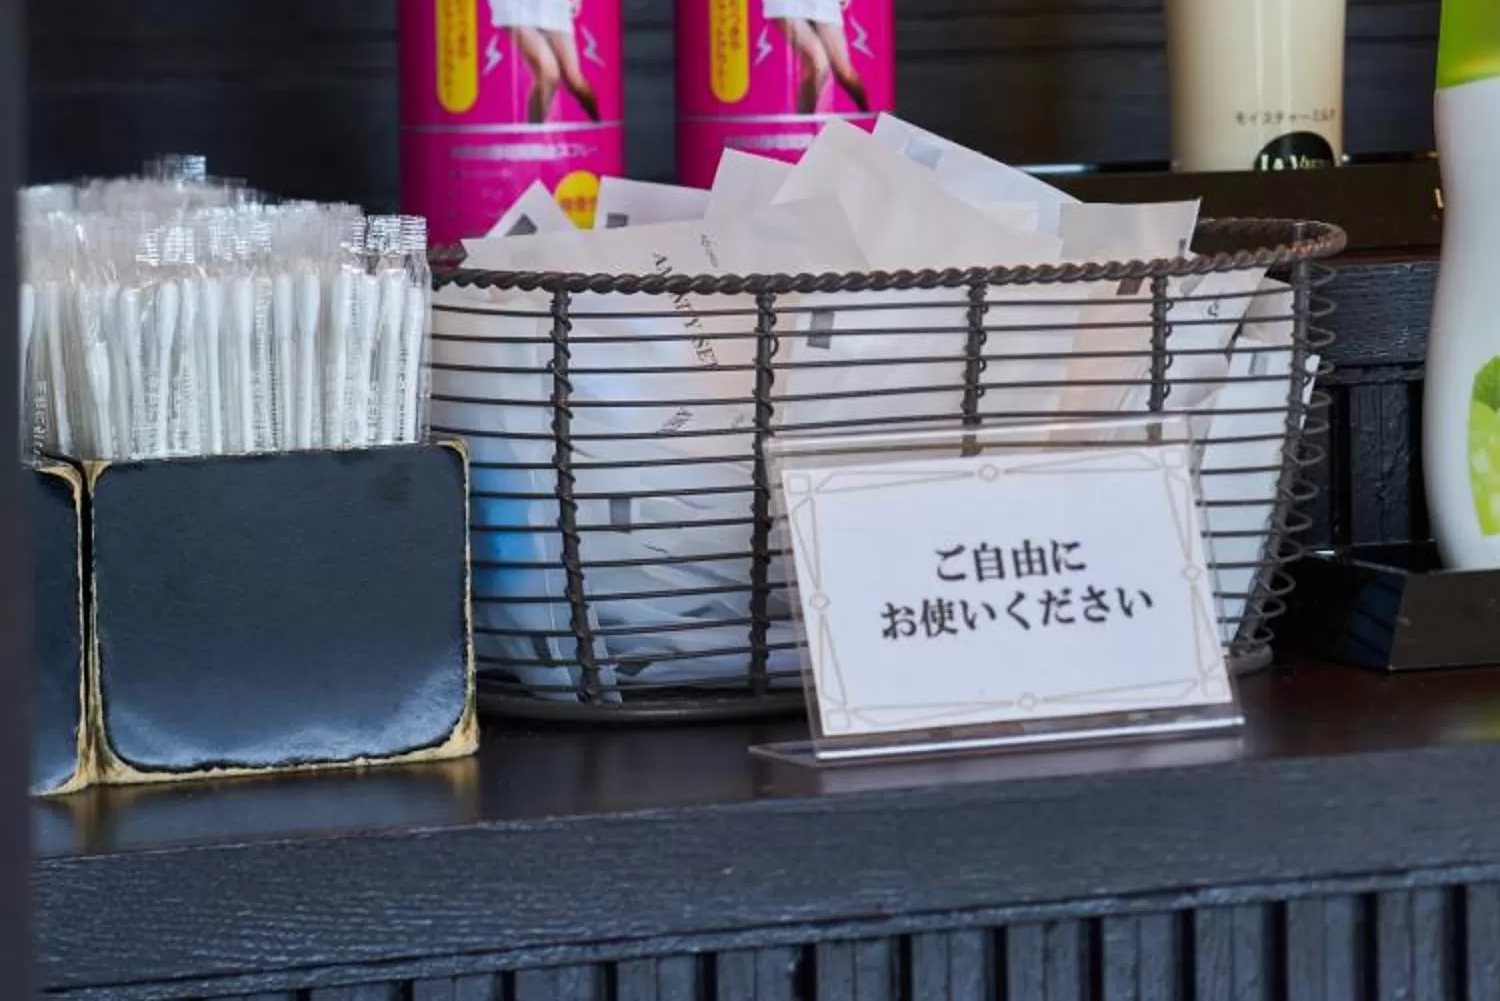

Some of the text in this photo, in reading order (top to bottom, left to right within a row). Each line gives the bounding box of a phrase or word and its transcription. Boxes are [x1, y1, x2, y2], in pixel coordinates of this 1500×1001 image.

[934, 539, 1087, 584] ご自由に
[880, 585, 1154, 641] お使いください
